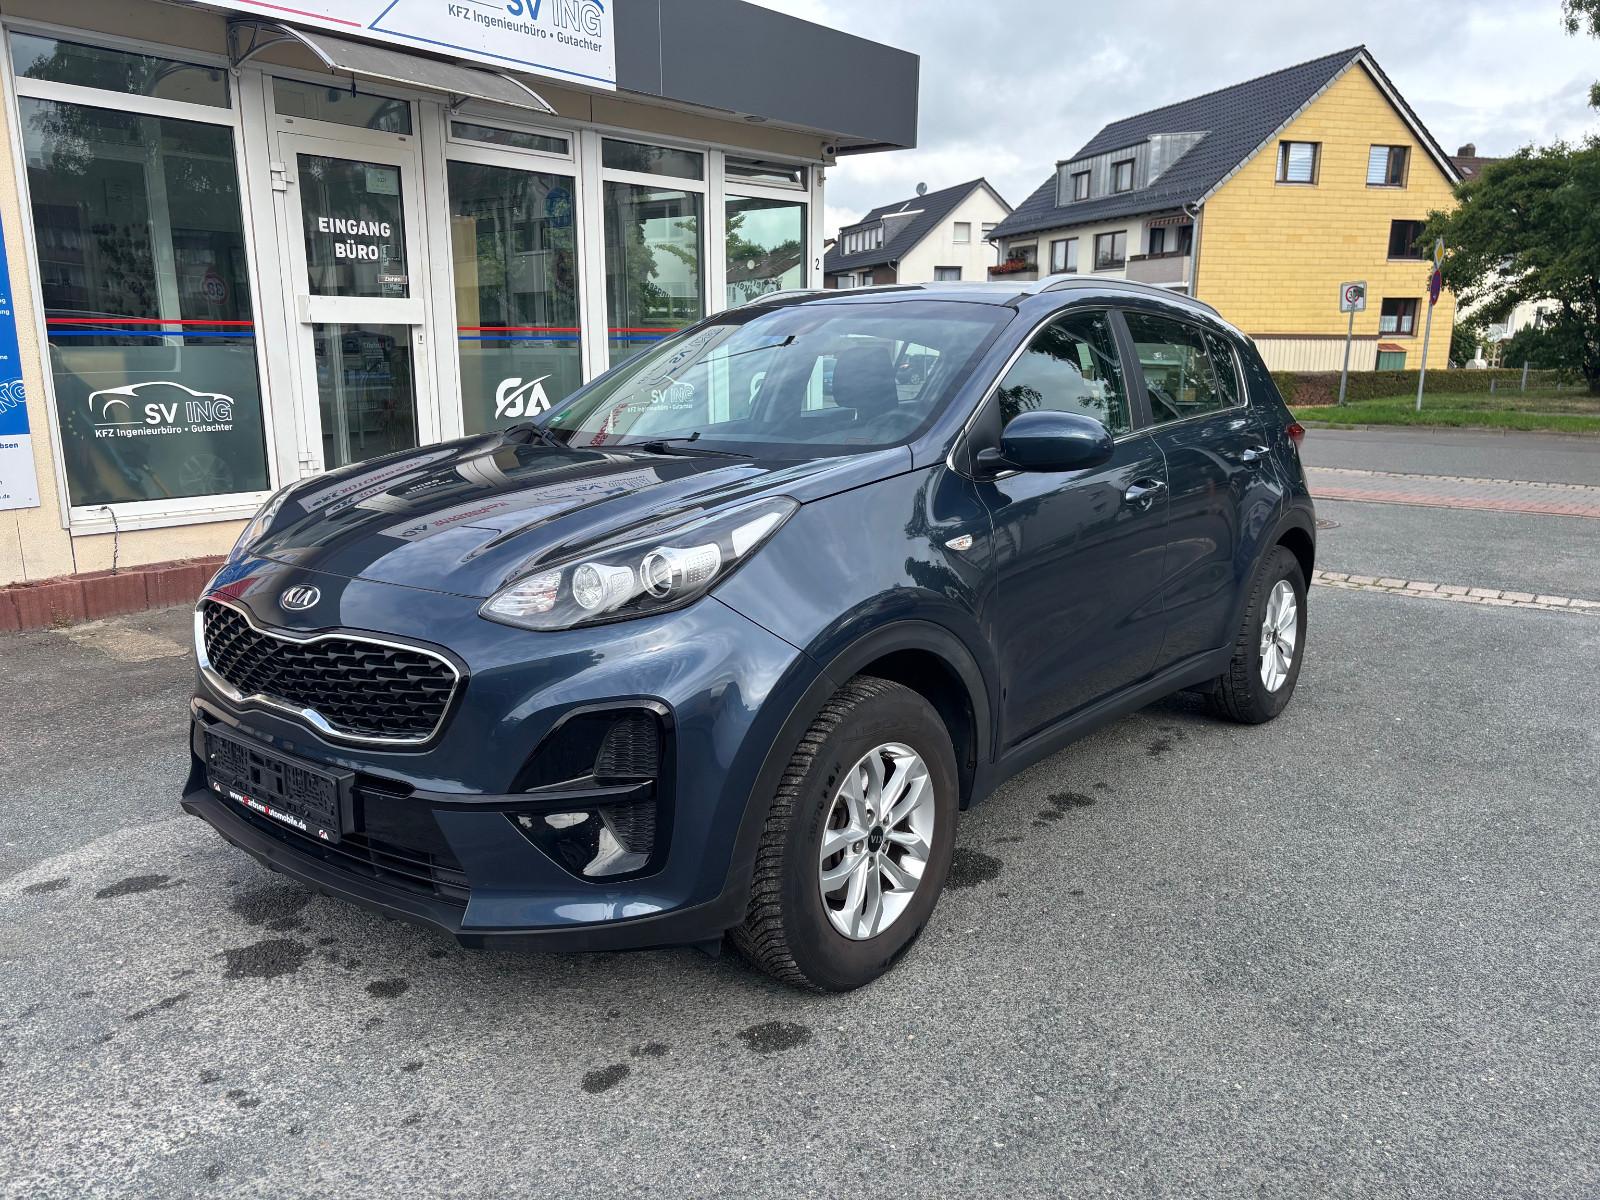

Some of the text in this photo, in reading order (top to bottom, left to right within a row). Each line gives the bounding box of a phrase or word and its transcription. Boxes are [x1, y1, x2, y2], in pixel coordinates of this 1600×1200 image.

[448, 4, 603, 53] KFZ Ingenieurbüro Gutachter
[318, 216, 391, 238] EINGANG
[335, 239, 379, 260] BÜRO
[815, 258, 820, 271] 2
[650, 389, 667, 404] SV
[144, 401, 232, 425] SV ING
[95, 423, 233, 438] KFZ Ingenieurbüro Gutachter
[284, 587, 313, 606] KIA
